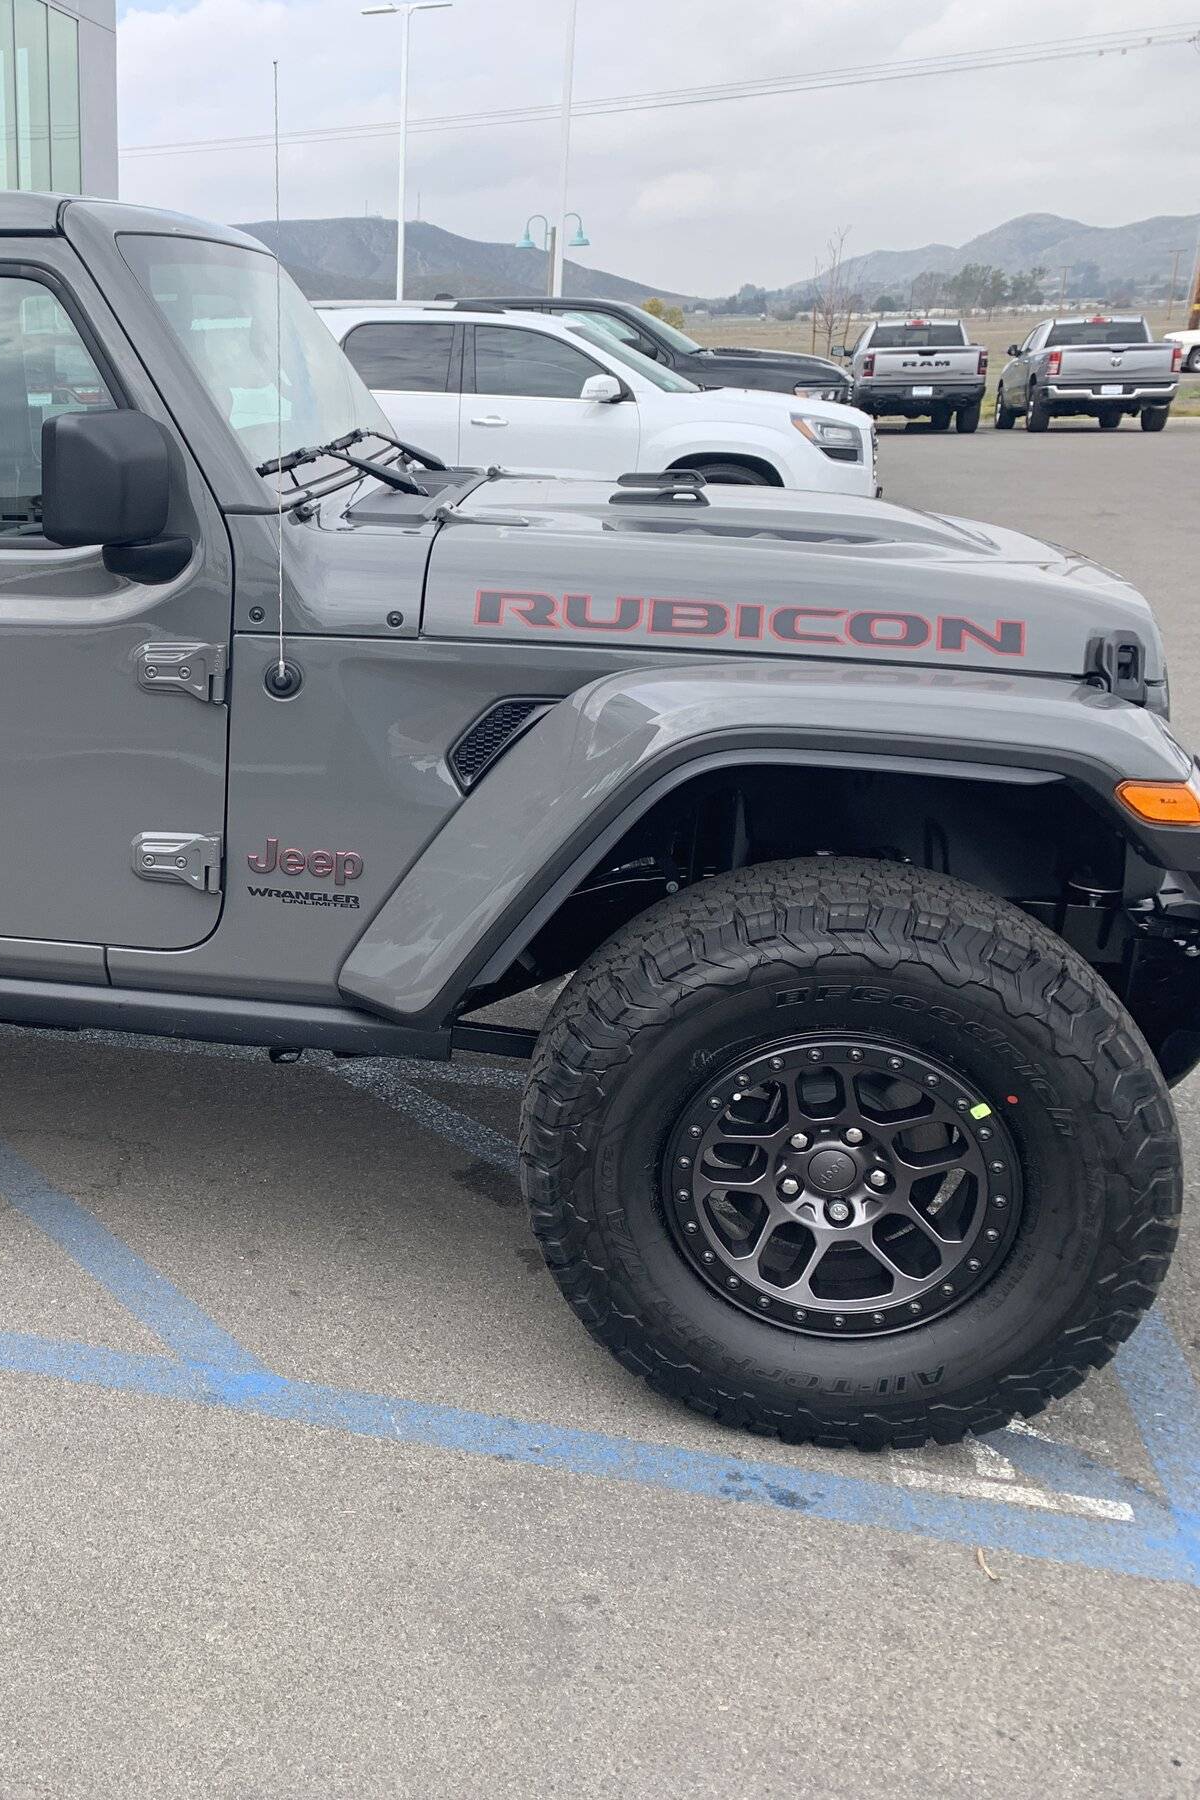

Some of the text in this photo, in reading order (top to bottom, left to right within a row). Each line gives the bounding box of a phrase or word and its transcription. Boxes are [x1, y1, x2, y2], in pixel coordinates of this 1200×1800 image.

[902, 360, 951, 368] RAM
[474, 588, 1027, 657] RUBICON
[247, 837, 364, 886] Jeep
[247, 886, 360, 905] WRANGLER
[282, 898, 360, 909] UNLIMITED
